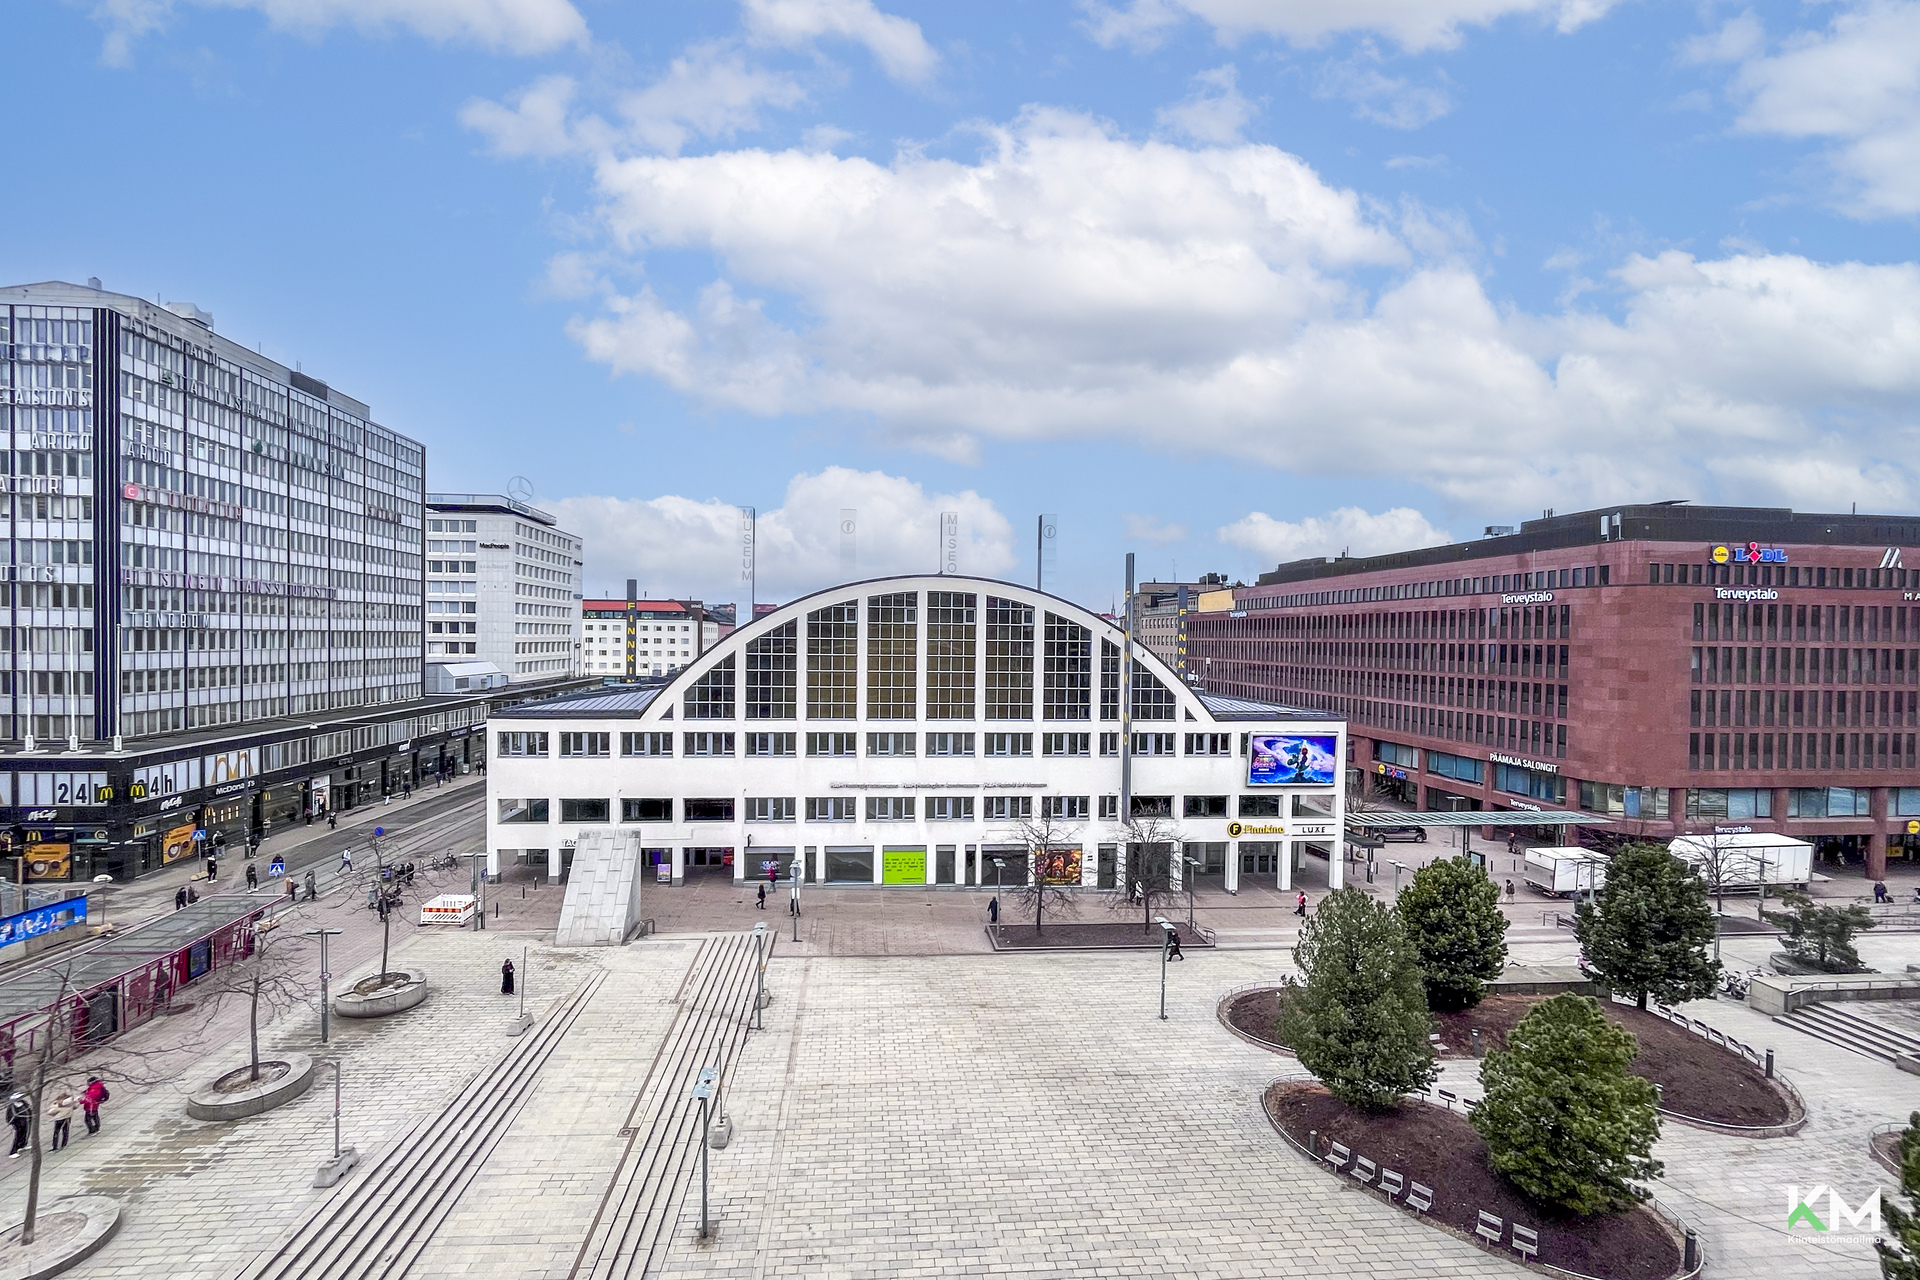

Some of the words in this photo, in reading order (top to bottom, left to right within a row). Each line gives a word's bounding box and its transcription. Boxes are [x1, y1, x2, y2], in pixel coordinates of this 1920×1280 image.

[32, 433, 90, 450] ARCO
[128, 441, 171, 466] ARCO
[742, 508, 752, 581] MUSEUM
[947, 514, 957, 573] MUSEO
[1501, 590, 1553, 605] Terveystalo
[1715, 587, 1779, 602] Terveystalo
[129, 611, 210, 628] TENGBOM
[1489, 752, 1521, 767] PÄÄMAJA
[1522, 759, 1558, 773] SALONGIT
[136, 774, 173, 796] 4h
[215, 780, 255, 795] McDona's
[1302, 826, 1326, 834] LUXE
